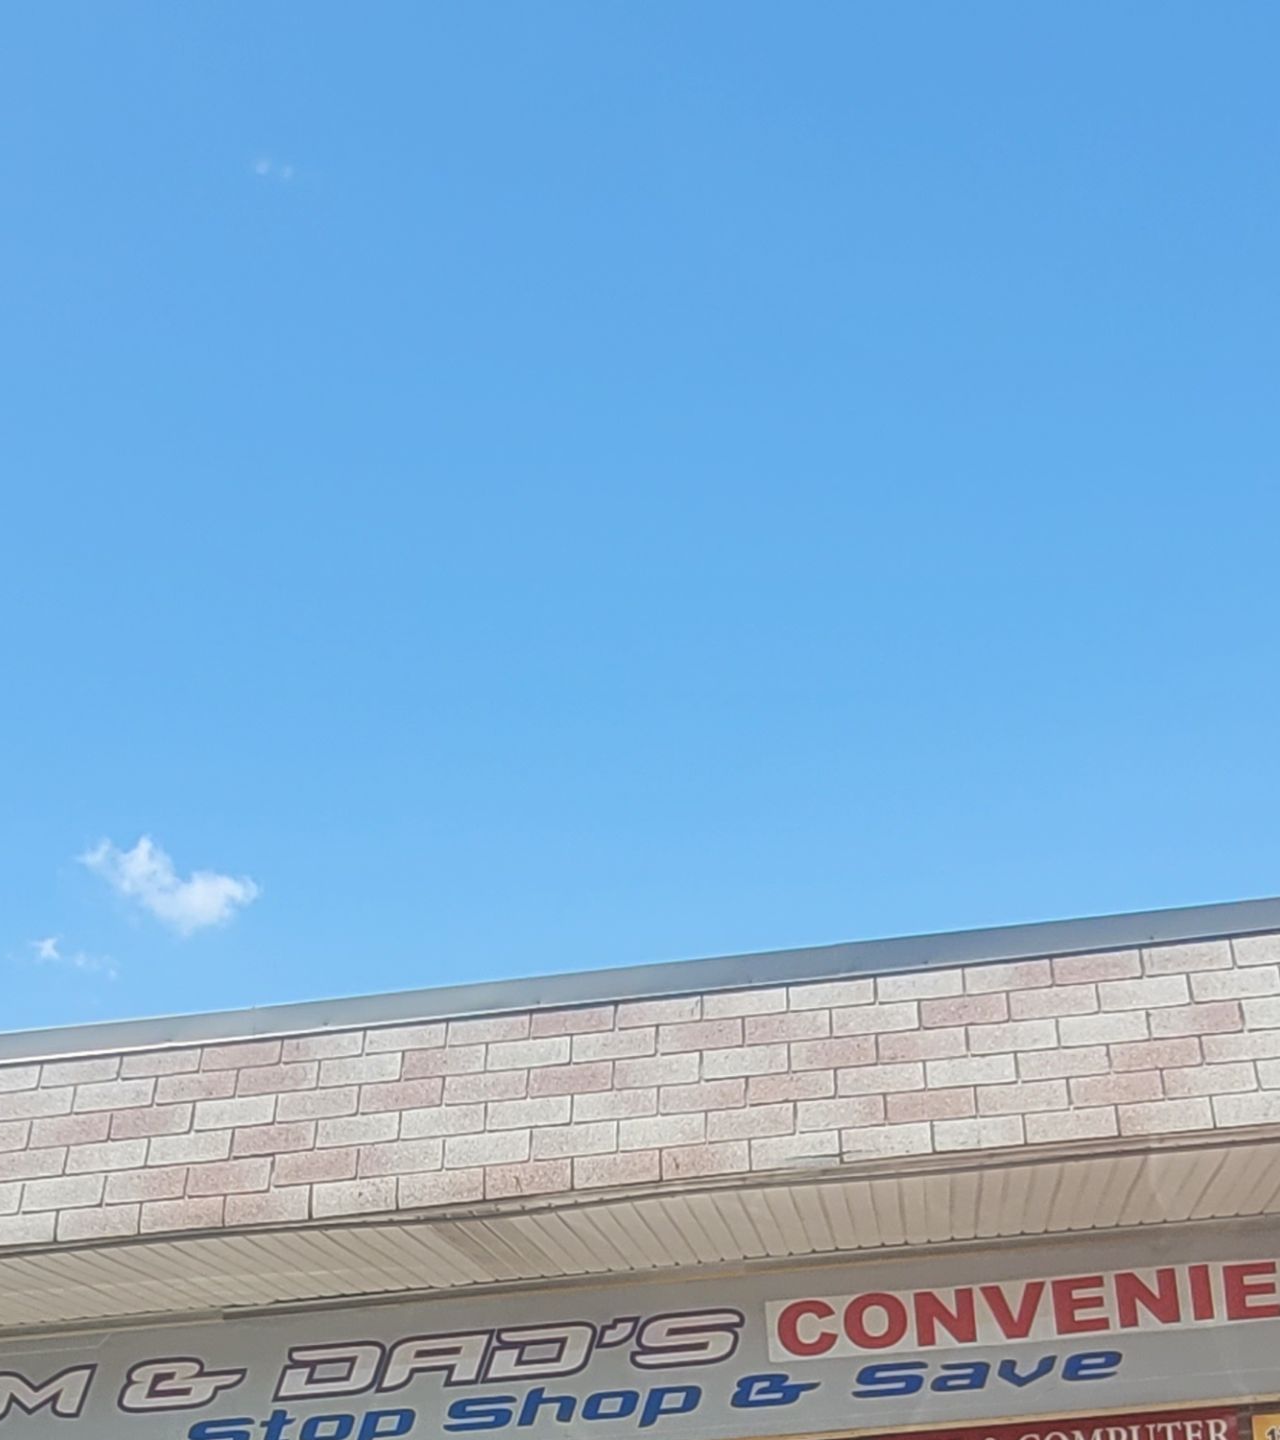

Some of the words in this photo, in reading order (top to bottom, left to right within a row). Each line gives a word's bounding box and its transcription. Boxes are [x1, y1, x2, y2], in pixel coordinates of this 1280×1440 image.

[118, 1357, 247, 1412] &
[273, 1309, 744, 1402] DAD'S
[730, 1373, 820, 1410] &
